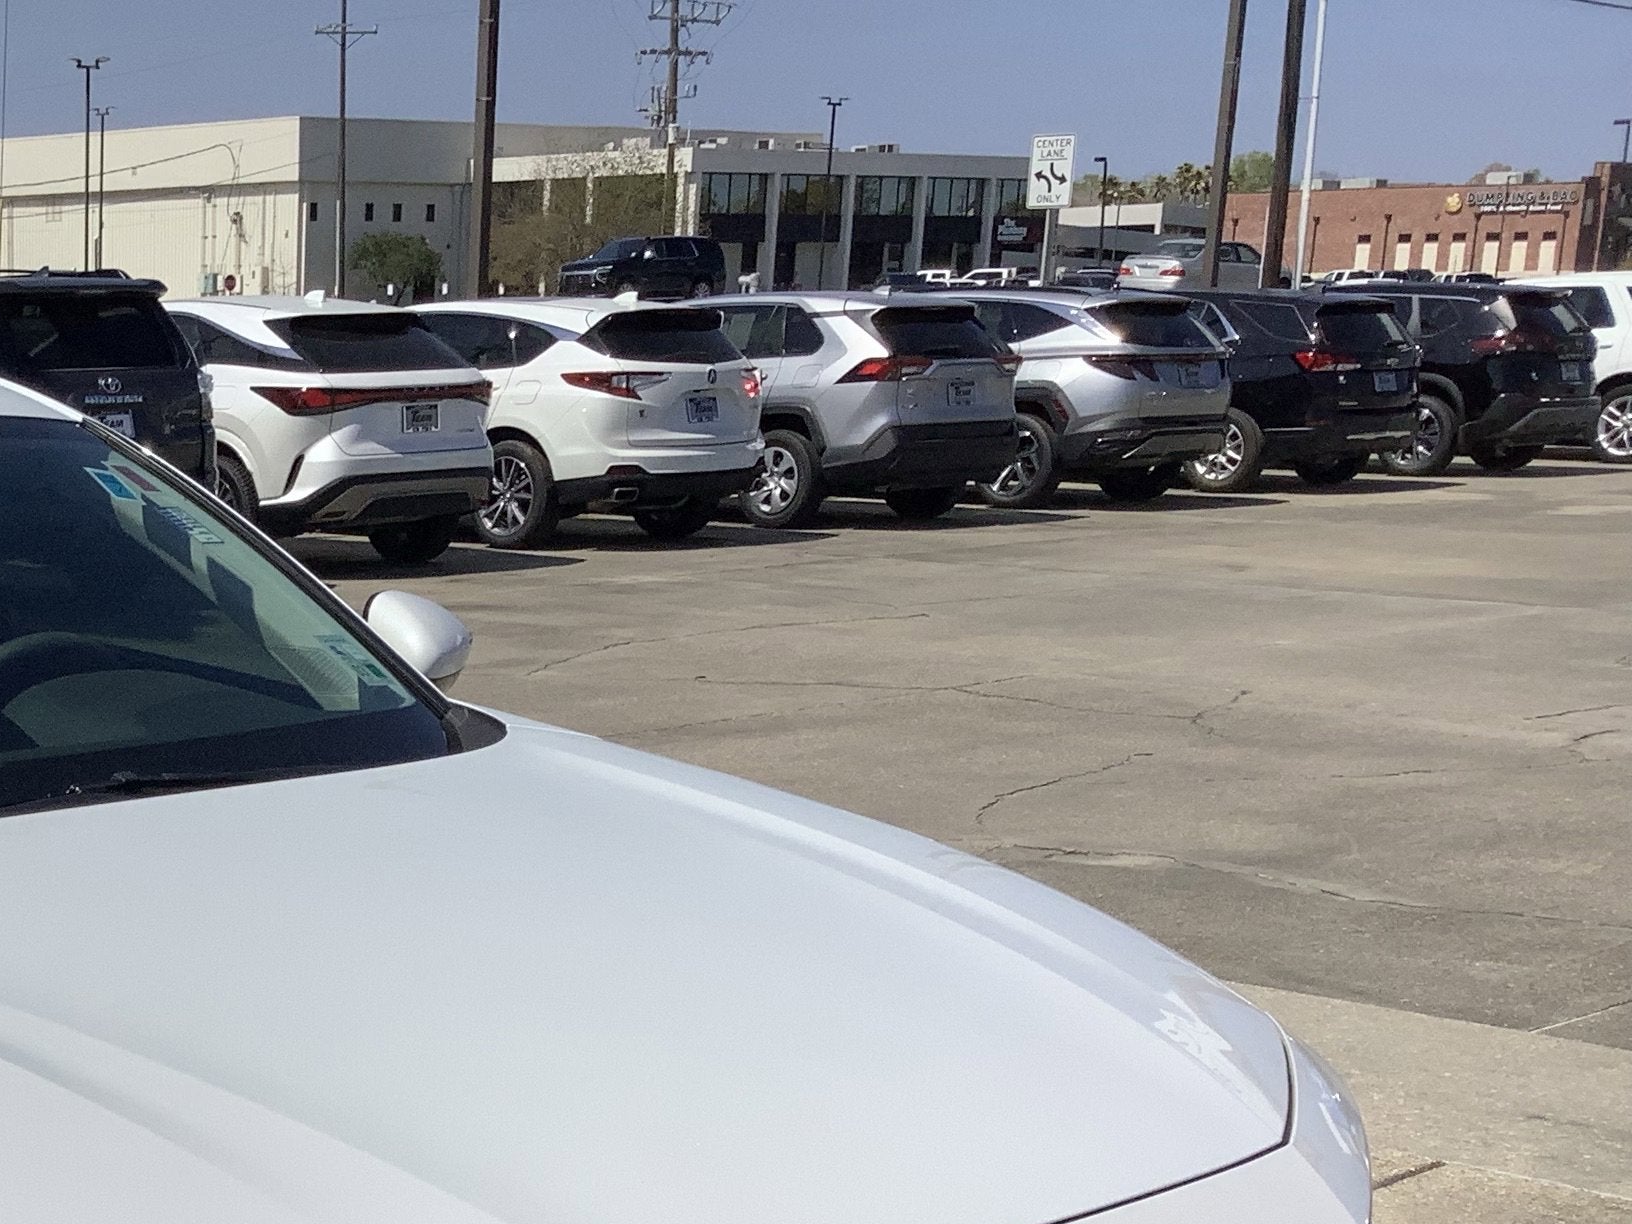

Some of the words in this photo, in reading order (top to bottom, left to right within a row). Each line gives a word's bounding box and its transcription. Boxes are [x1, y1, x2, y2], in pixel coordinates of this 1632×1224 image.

[1036, 138, 1073, 149] CENTER
[1040, 149, 1066, 158] LANE
[1036, 194, 1062, 204] ONLY
[1467, 191, 1535, 204] DUMPING
